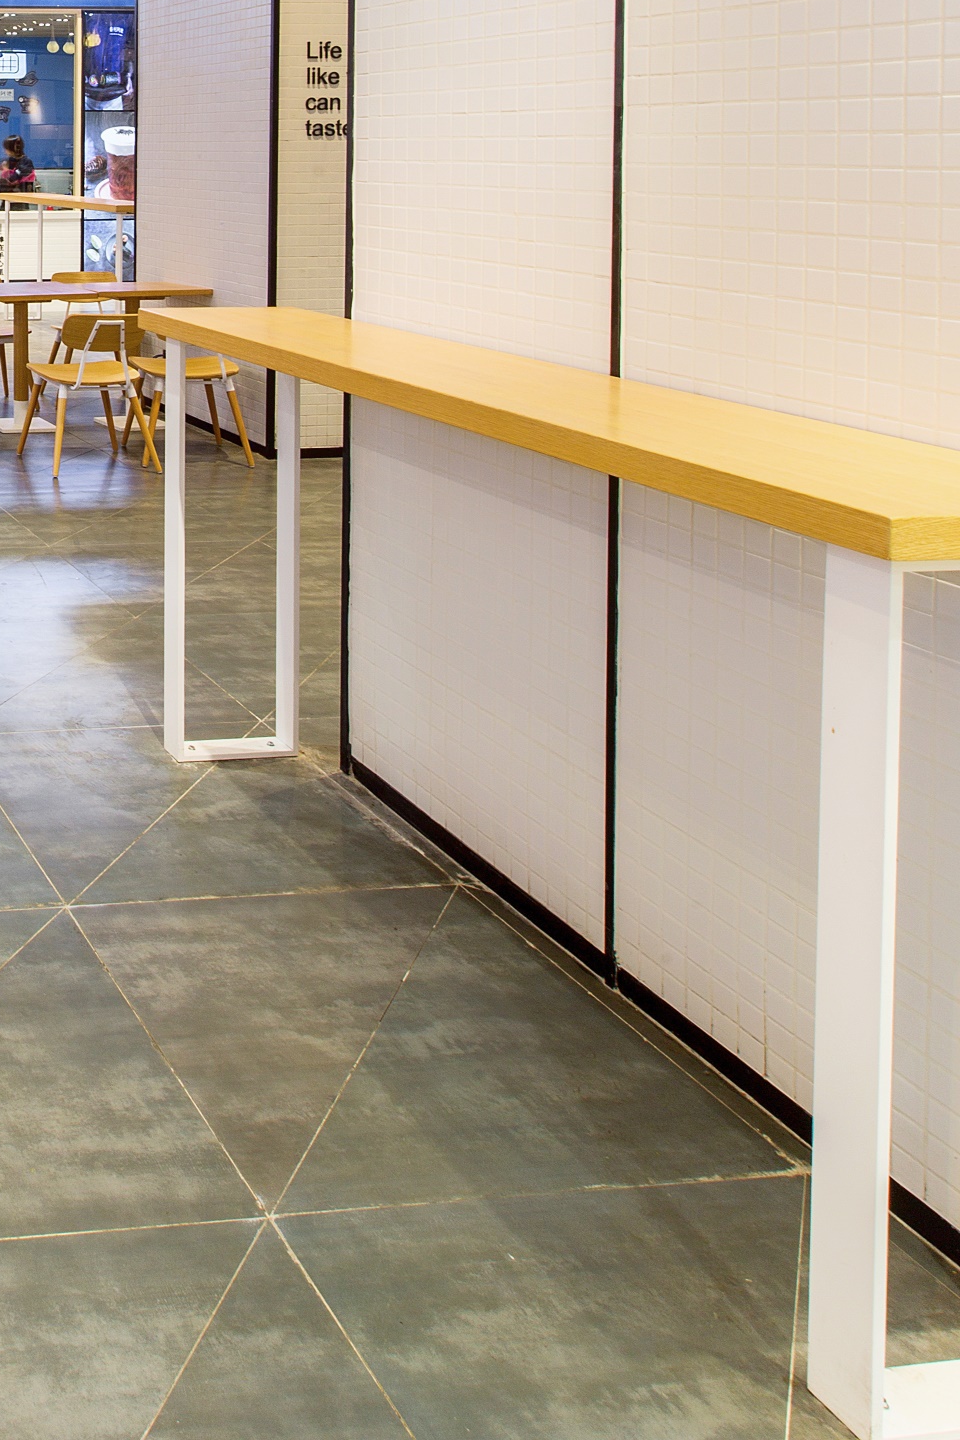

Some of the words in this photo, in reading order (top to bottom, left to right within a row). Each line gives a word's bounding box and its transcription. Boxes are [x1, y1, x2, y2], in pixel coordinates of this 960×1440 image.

[306, 41, 343, 59] Life
[306, 67, 340, 85] like
[305, 97, 341, 111] can
